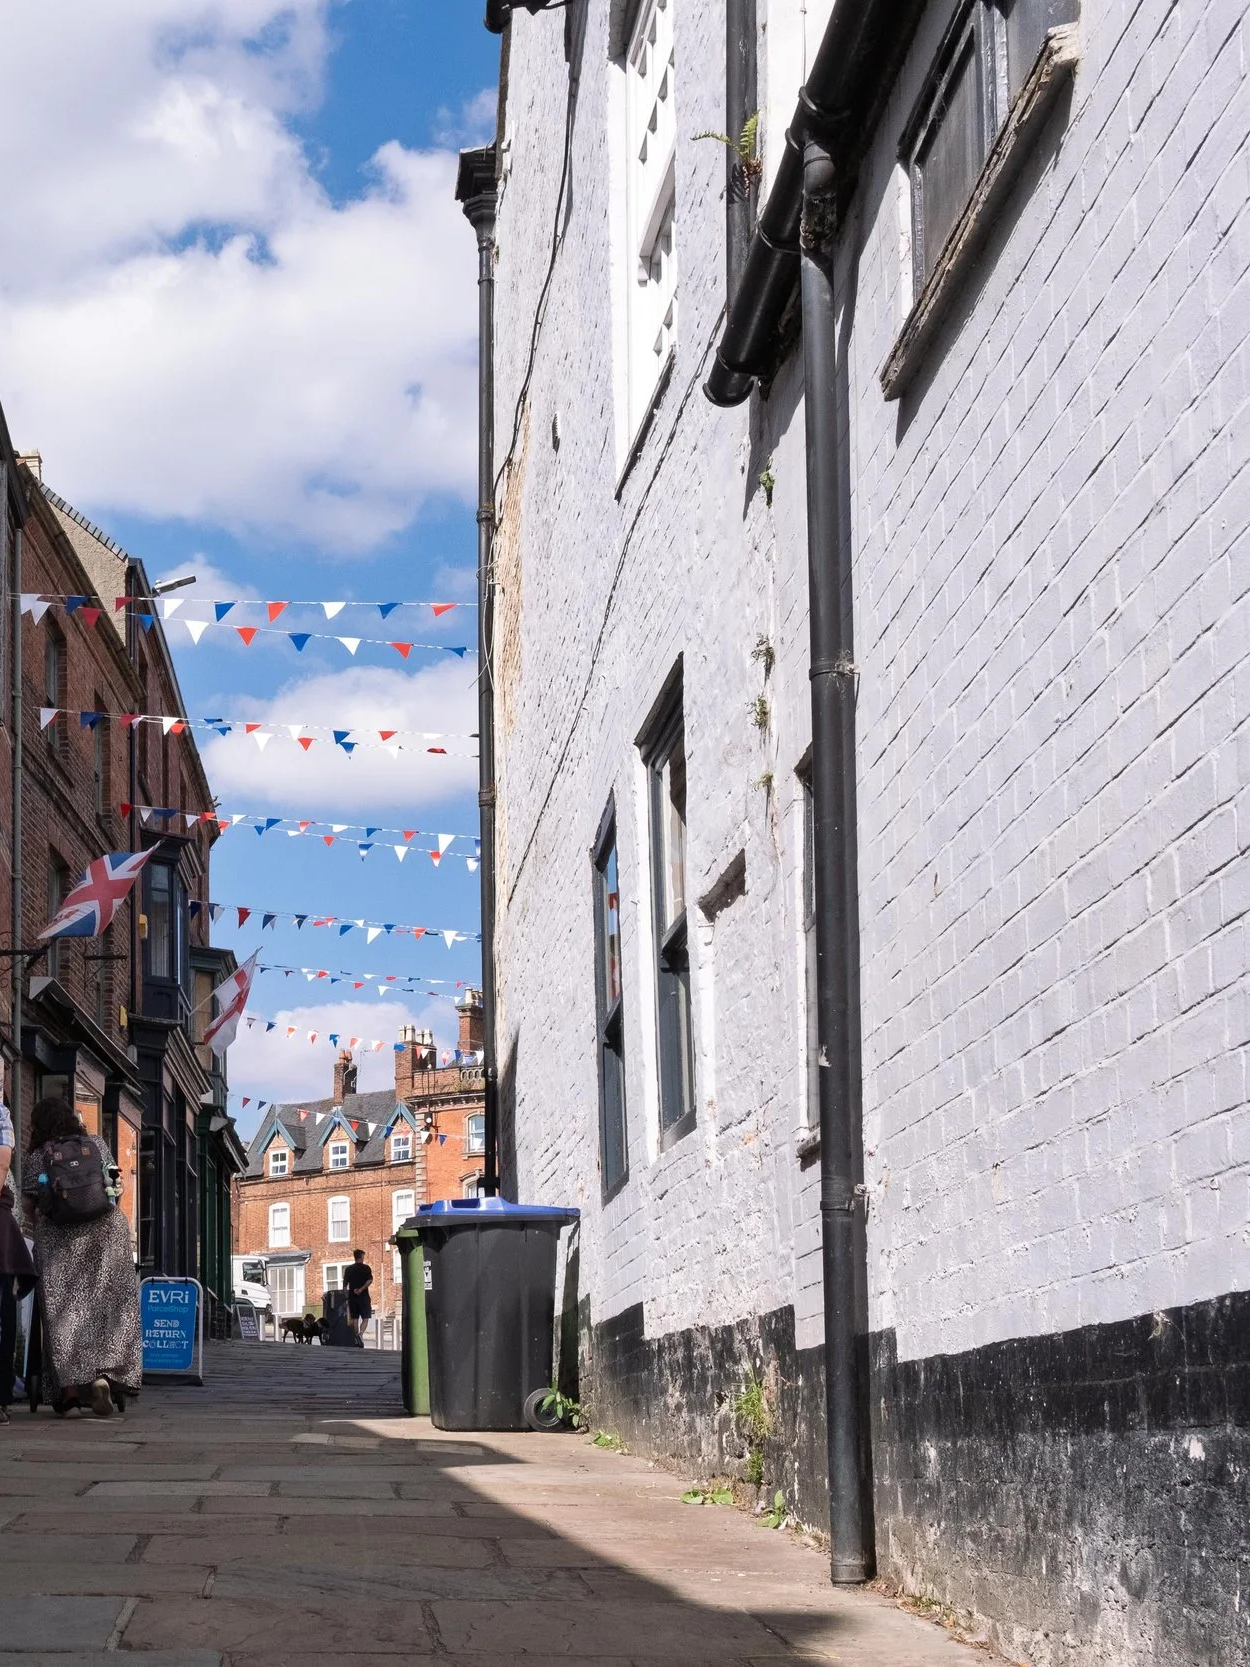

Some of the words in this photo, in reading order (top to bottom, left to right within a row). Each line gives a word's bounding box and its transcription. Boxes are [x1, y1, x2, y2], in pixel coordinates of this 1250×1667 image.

[147, 1305, 189, 1315] ParcelShop
[153, 1319, 180, 1328] SEND
[145, 1329, 187, 1338] RETURN
[142, 1340, 189, 1349] COLLECT
